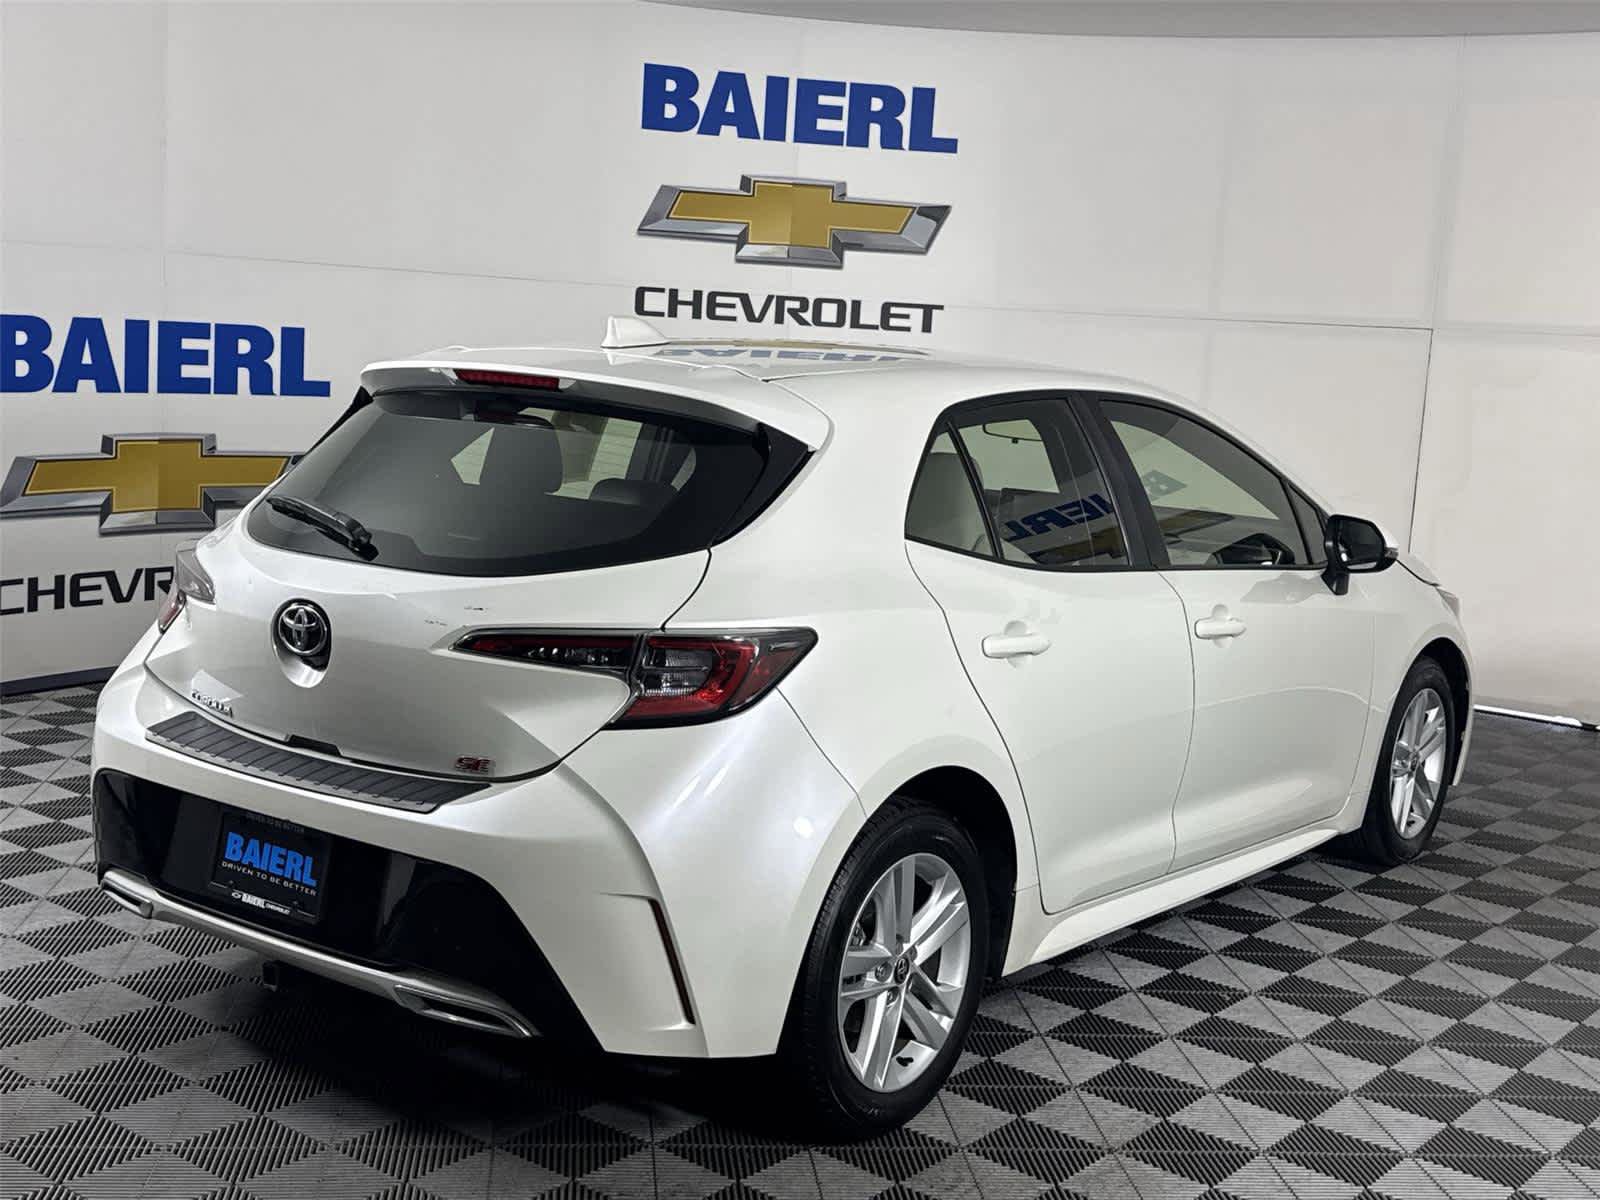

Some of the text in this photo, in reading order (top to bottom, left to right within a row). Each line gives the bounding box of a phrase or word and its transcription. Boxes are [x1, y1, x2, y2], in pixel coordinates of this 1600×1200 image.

[641, 62, 959, 154] BAIERL
[634, 285, 945, 333] CHEVROLET
[0, 313, 331, 397] BAIERL
[221, 861, 317, 897] DRIVEN TO BE BETTER
[224, 831, 317, 887] BAIERL
